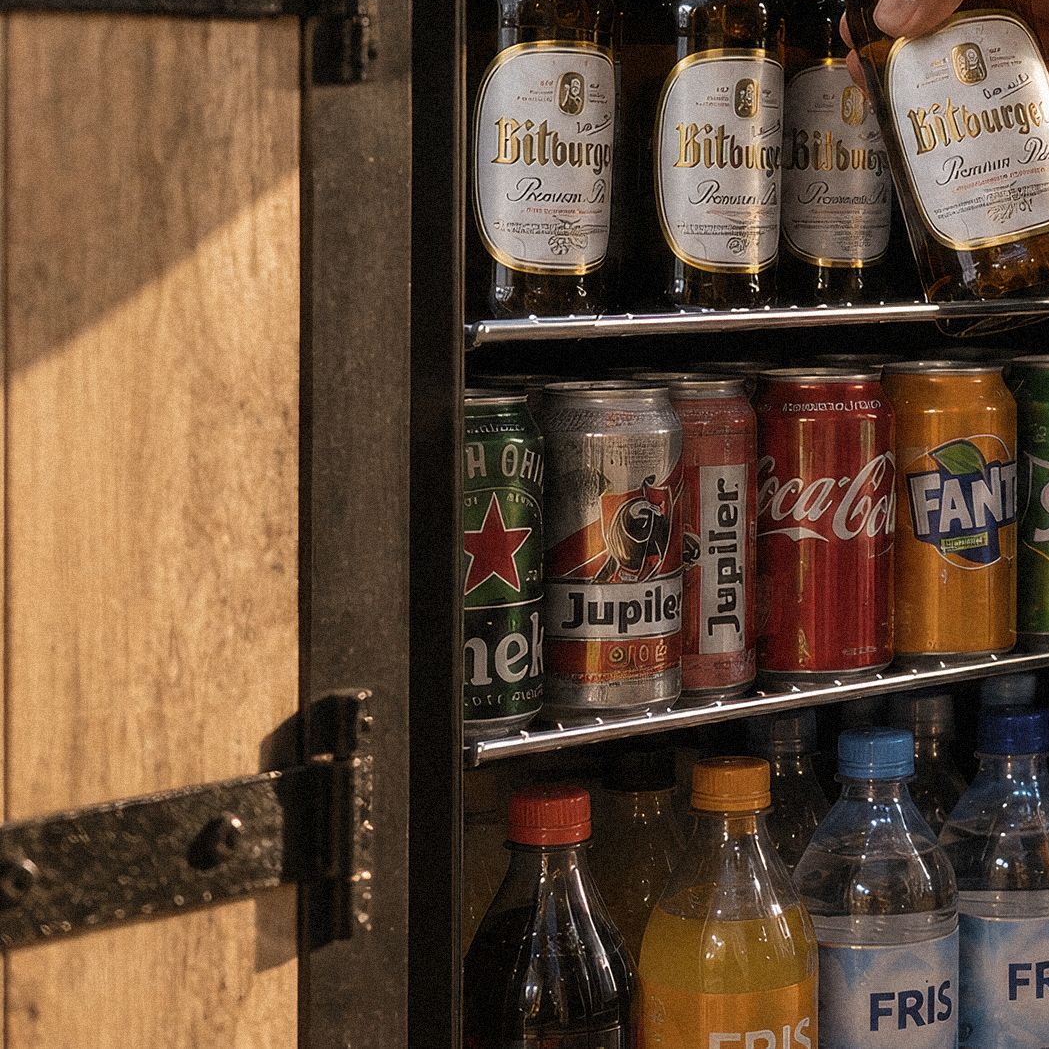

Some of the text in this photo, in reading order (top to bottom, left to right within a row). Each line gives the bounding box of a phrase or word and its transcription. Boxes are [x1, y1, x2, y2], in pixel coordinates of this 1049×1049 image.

[707, 477, 743, 638] Jupiler
[560, 584, 682, 635] Jupile
[869, 979, 953, 1032] FRIS
